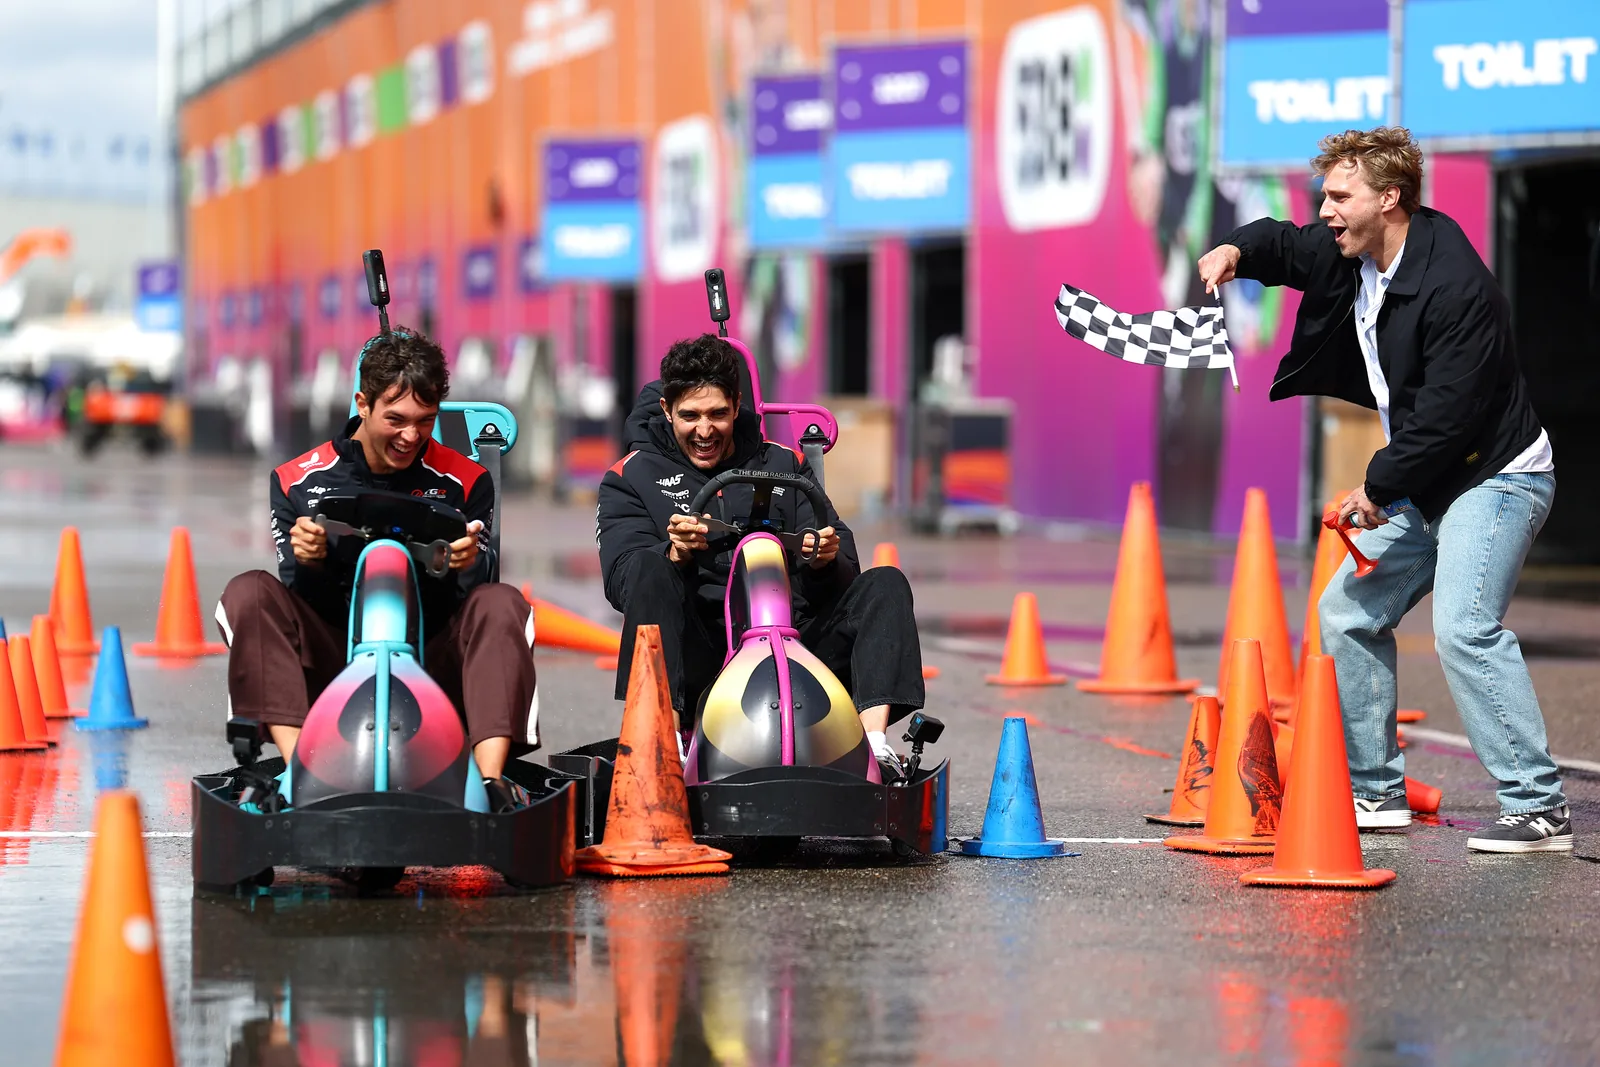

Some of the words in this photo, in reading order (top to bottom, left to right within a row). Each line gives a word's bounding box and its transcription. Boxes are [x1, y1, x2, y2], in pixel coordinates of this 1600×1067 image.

[1433, 37, 1598, 90] TOILET
[1248, 76, 1389, 124] TOILET
[655, 473, 684, 487] HAAS
